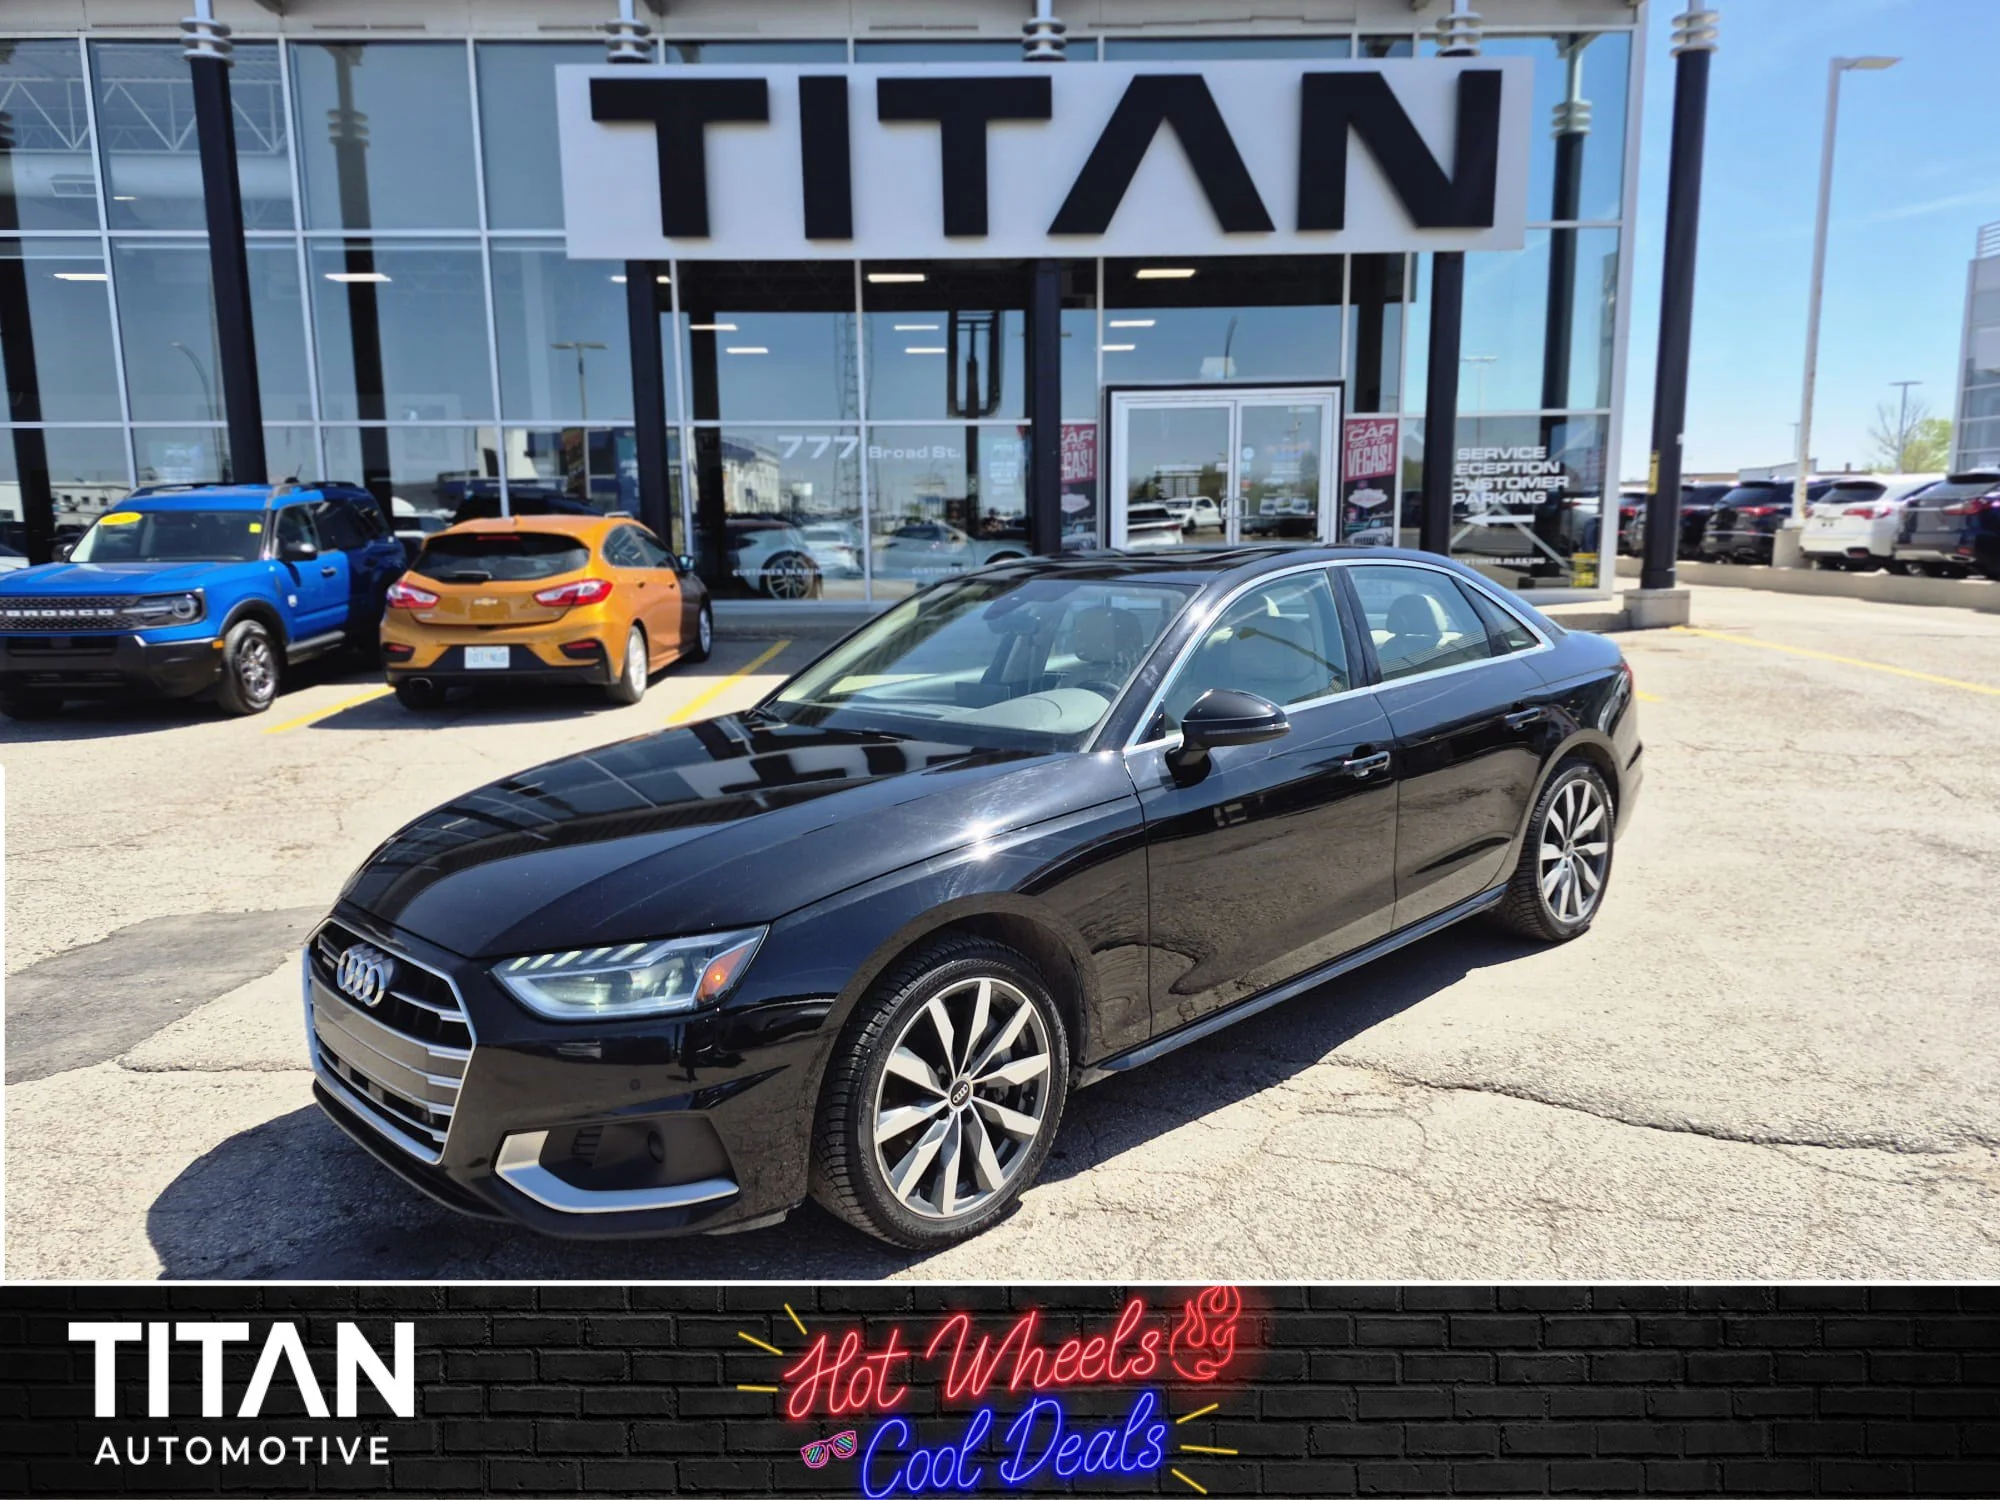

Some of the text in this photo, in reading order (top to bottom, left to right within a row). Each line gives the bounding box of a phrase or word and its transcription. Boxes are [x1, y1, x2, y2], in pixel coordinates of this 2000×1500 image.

[590, 70, 1504, 240] TITAN
[1348, 423, 1396, 443] CAR
[777, 435, 961, 459] 777 Broad St.
[1456, 446, 1547, 460] SERVICE
[1346, 443, 1394, 478] VEGAS!
[1454, 461, 1560, 476] ECEPTION
[1452, 491, 1548, 506] PARKING
[5, 609, 115, 617] BRONCO
